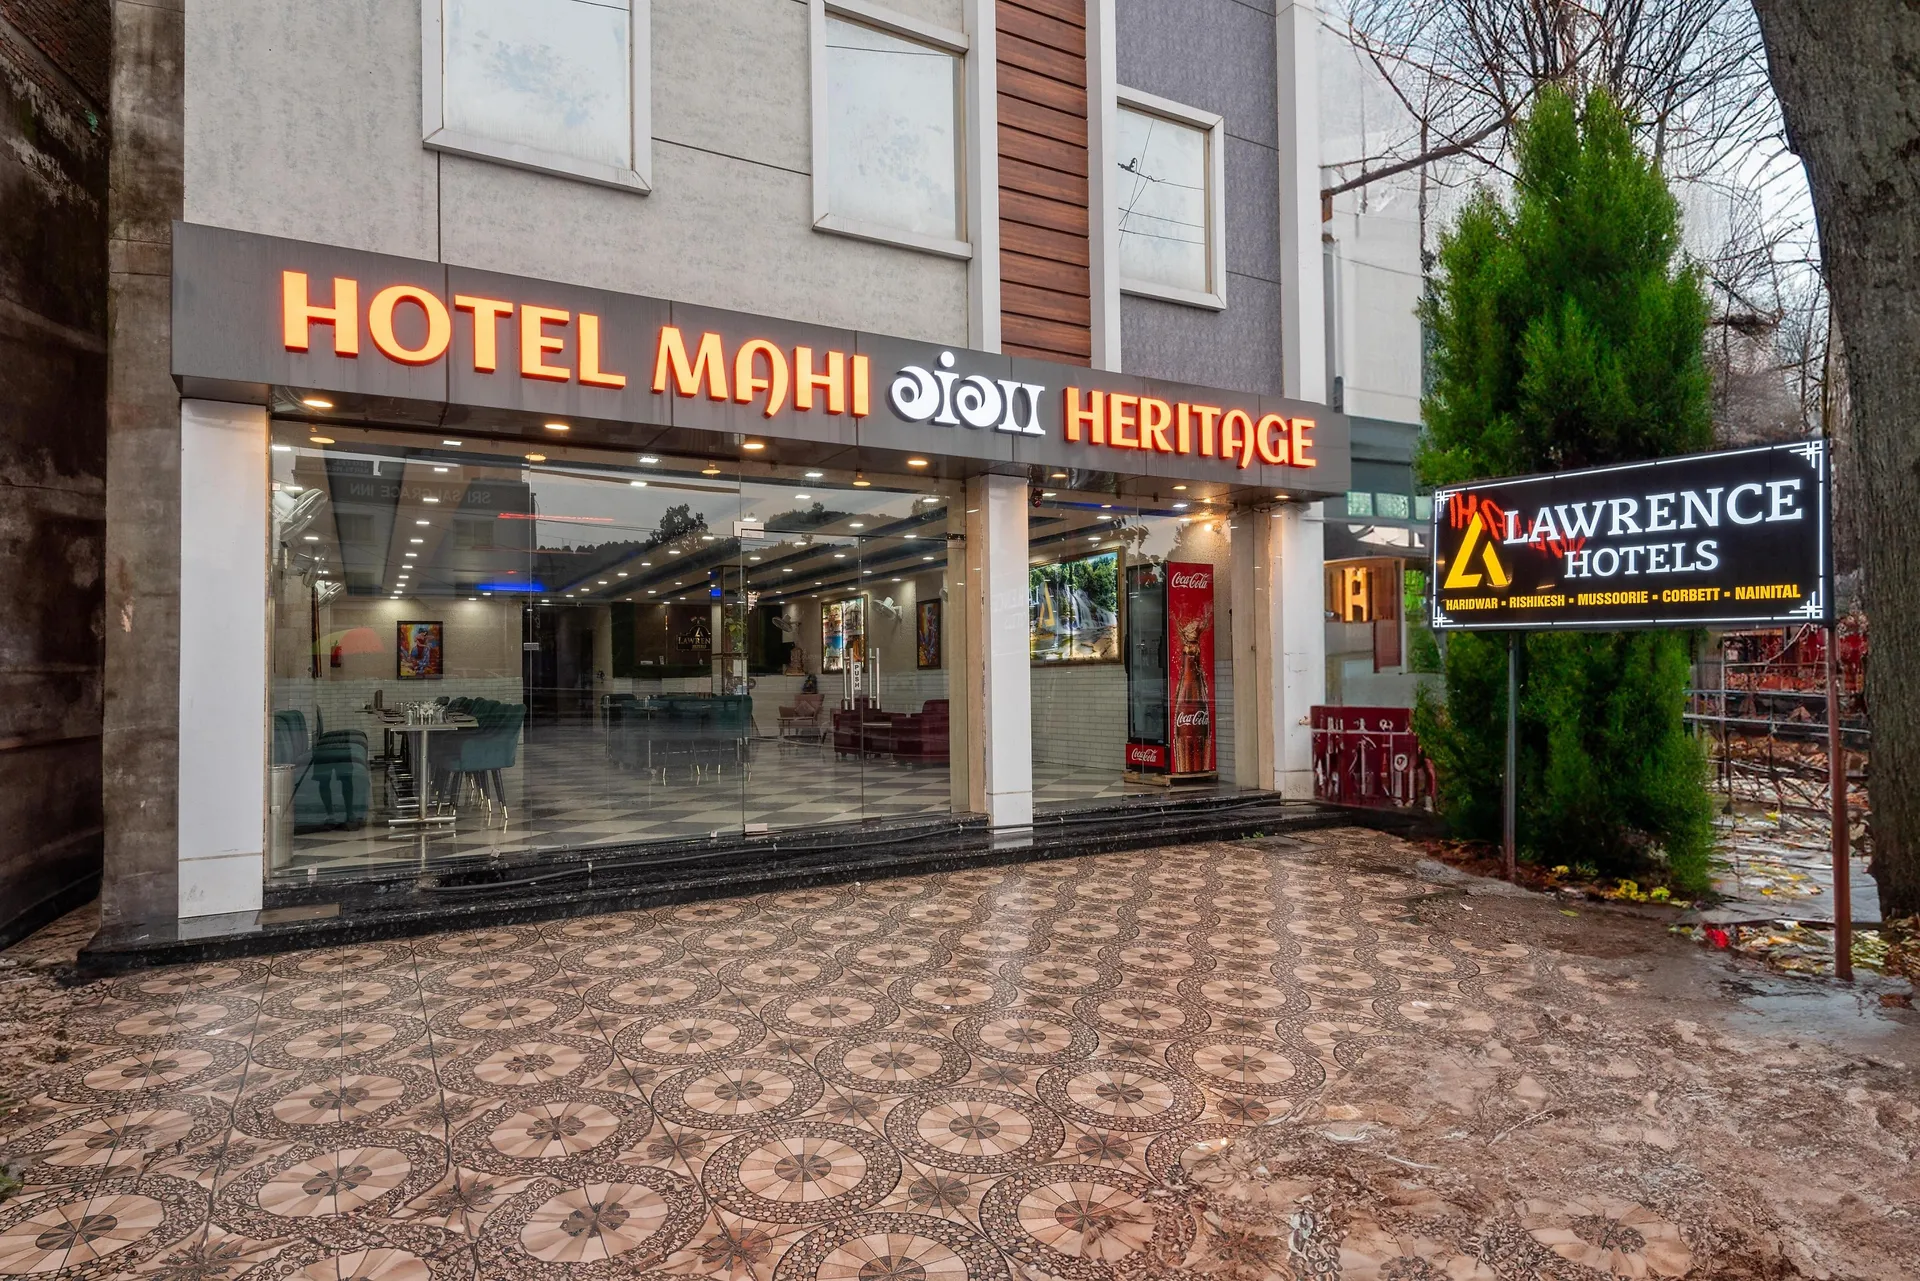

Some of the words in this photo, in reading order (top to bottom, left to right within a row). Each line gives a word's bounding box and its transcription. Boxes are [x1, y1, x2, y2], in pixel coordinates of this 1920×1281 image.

[282, 270, 626, 388] HOTEL
[650, 325, 870, 419] MAHI
[1064, 386, 1317, 469] HERITAGE
[1503, 478, 1803, 546] LAWRENCE
[1563, 540, 1719, 579] HOTELS
[1171, 571, 1210, 589] Coca-Cola
[1445, 597, 1498, 611] HARIDWAR
[1509, 595, 1565, 608] RISHIKESH
[1577, 591, 1648, 607] MUSSOORIE
[1662, 588, 1720, 603] CORBETT
[1735, 584, 1801, 600] NAINITAL
[1176, 710, 1210, 727] Coca-Cola
